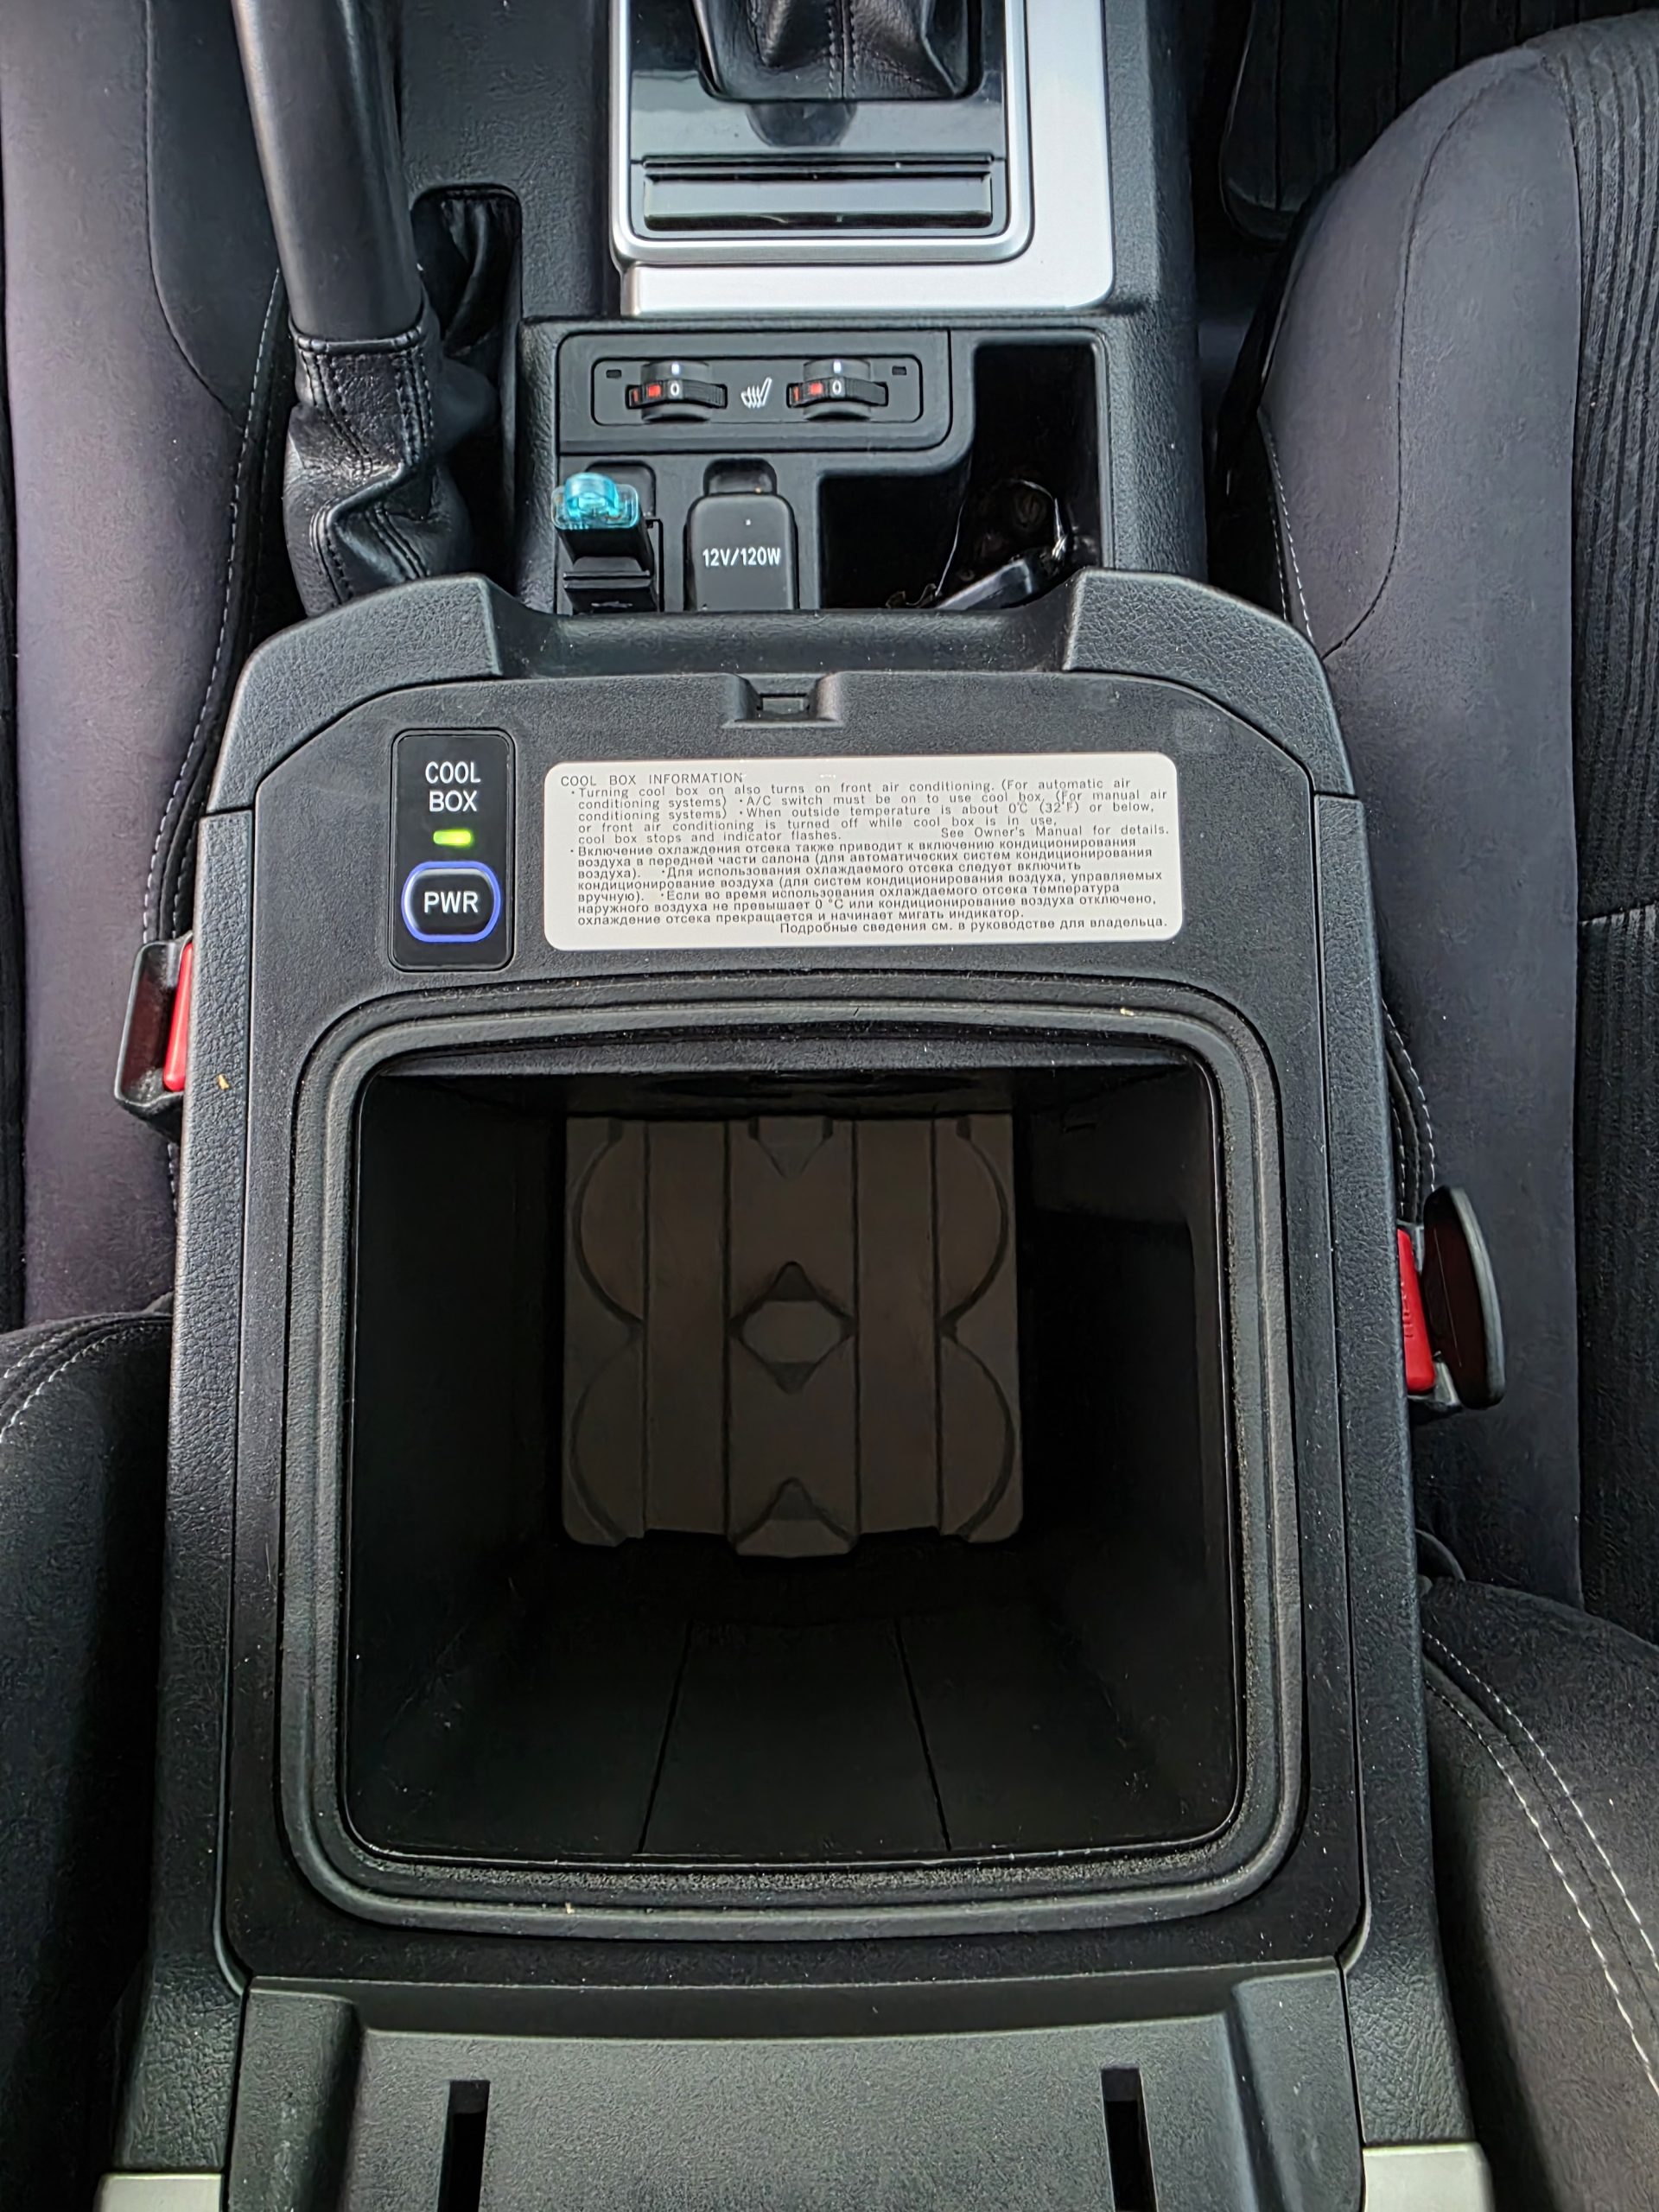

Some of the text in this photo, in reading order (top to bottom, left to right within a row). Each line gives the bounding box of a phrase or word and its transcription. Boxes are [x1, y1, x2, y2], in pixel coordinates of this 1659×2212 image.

[702, 547, 782, 569] 12V/120W
[425, 761, 481, 784] COOL
[560, 772, 742, 786] COOL BOX INFORMATION
[580, 777, 1130, 799] Turning cool box on also turns on front air conditioning. (For automatic air
[429, 791, 478, 812] BOX
[578, 797, 659, 811] conditioning
[668, 796, 727, 810] systems)
[746, 795, 771, 806] A/C
[781, 794, 823, 805] switch
[833, 793, 864, 804] must
[875, 793, 891, 804] be
[900, 795, 916, 804] on
[926, 792, 939, 803] to
[949, 794, 971, 803] use
[981, 791, 1007, 802] cool
[1055, 790, 1082, 803] (For
[1092, 789, 1140, 800] manual
[1149, 788, 1166, 799] air
[578, 809, 659, 823] conditioning
[668, 808, 727, 821] systems)
[791, 805, 840, 817] outside
[849, 804, 931, 818] temperature
[940, 804, 951, 814] is
[962, 803, 998, 814] about
[1089, 804, 1102, 812] or
[1112, 800, 1154, 813] below,
[601, 821, 632, 832] front
[643, 821, 661, 831] air
[672, 819, 753, 833] conditioning
[765, 818, 776, 830] is
[787, 817, 830, 829] turned
[841, 817, 857, 828] off
[868, 817, 902, 828] while
[913, 816, 940, 827] cool
[951, 816, 974, 826] box
[985, 815, 996, 825] is
[1007, 815, 1019, 825] in
[941, 823, 1168, 837] See Owner's Manual for details.
[578, 829, 841, 845] cool box stops and indicator flashes.
[578, 844, 653, 855] Включение
[658, 845, 741, 856] охлаждения
[745, 844, 790, 853] отсека
[795, 843, 834, 852] также
[839, 842, 902, 854] приводит
[918, 841, 995, 850] включению
[999, 838, 1135, 851] кондиционирования
[577, 849, 1152, 869] воздуха в передней части салона (для автоматических систем кондиционирования
[577, 867, 640, 880] воздуха).
[697, 867, 800, 876] использования
[805, 865, 904, 877] охлаждаемого
[908, 864, 953, 873] отсека
[957, 863, 1012, 874] следует
[1017, 861, 1081, 871] включить
[577, 872, 1162, 892] кондиционирование воздуха (для систем кондиционирования воздуха, управляемых
[423, 891, 480, 913] PWR
[577, 884, 1119, 904] вручную). Если во время использования охлаждаемого отсека температура
[577, 904, 649, 916] наружного
[654, 903, 708, 914] воздуха
[712, 902, 728, 911] не
[733, 901, 810, 913] превышает
[849, 899, 873, 909] или
[878, 898, 1015, 911] кондиционирование
[1020, 896, 1074, 908] воздуха
[1078, 895, 1156, 906] отключено,
[577, 915, 660, 927] охлаждение
[665, 914, 710, 923] отсека
[715, 912, 812, 925] прекращается
[830, 911, 893, 920] начинает
[898, 910, 944, 919] мигать
[949, 909, 1024, 920] индикатор.
[779, 921, 857, 935] Подробные
[862, 922, 926, 934] сведения
[931, 922, 952, 931] см.
[970, 920, 1055, 931] руководстве
[1059, 919, 1084, 931] для
[1090, 918, 1167, 930] владельца.
